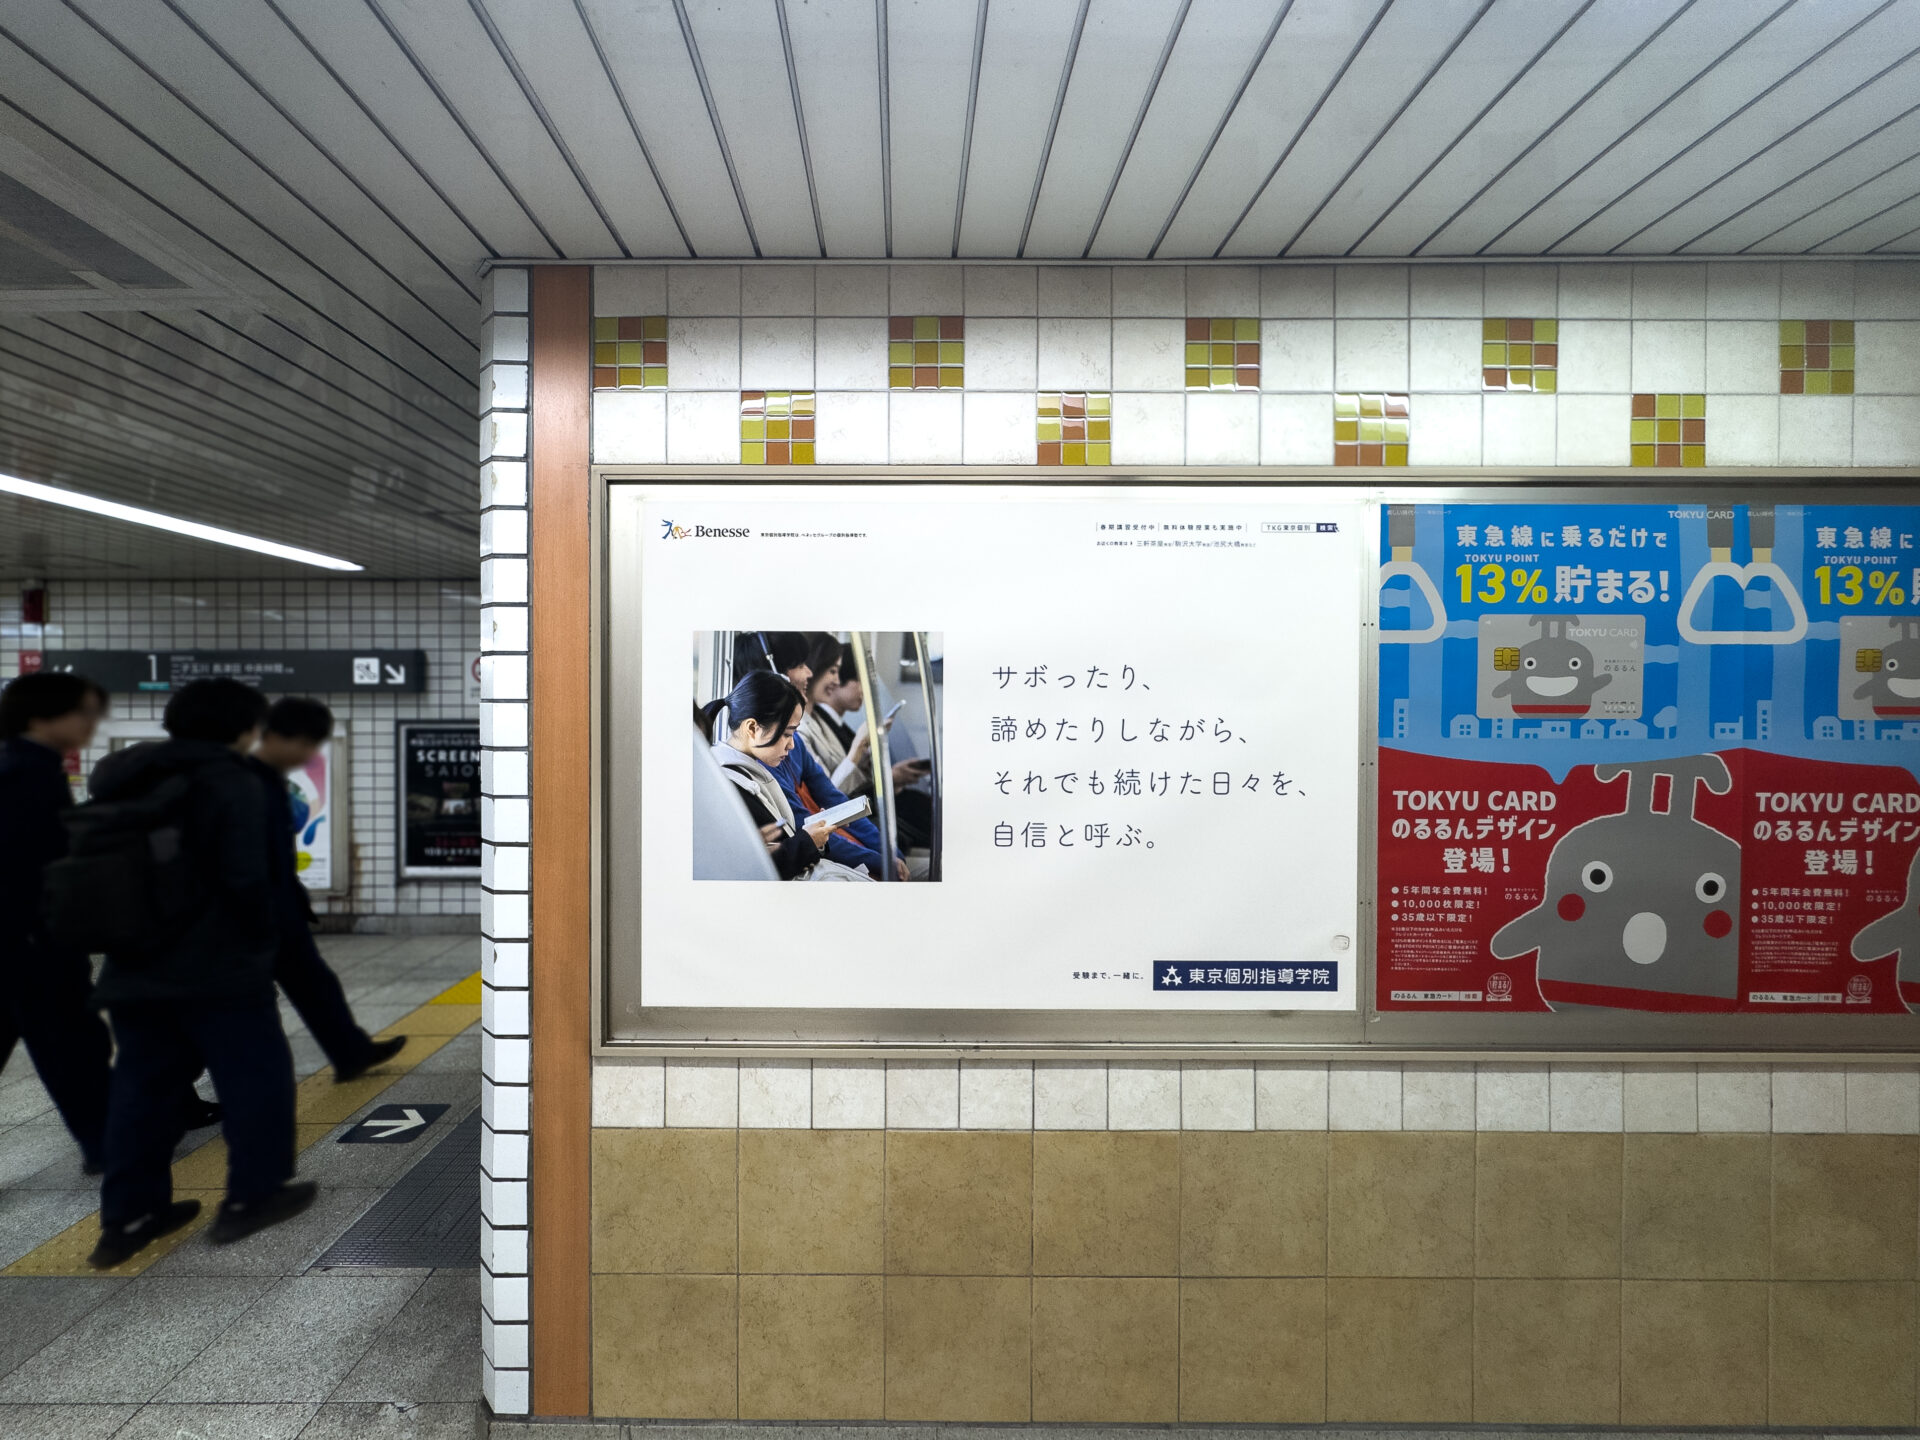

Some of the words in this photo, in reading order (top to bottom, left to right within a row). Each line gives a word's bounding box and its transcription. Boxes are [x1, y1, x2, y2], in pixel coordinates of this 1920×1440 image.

[1667, 509, 1705, 520] TOKYU
[1706, 509, 1736, 520] CARD
[694, 525, 750, 538] Benesse
[1455, 524, 1667, 548] 東急線に乗るだけで
[1464, 552, 1503, 563] TOKYU
[1505, 553, 1540, 564] POINT
[1823, 555, 1861, 565] TOKYU
[1863, 555, 1898, 565] POINT
[1814, 565, 1905, 606] 13%
[1568, 627, 1608, 638] TOKYU
[1608, 627, 1639, 638] CARD
[1603, 664, 1637, 672] のるるん
[991, 664, 1150, 691] サボったり、
[990, 715, 1247, 744] 諦めたりしながら、
[994, 768, 1306, 797] それでも続けた日々を、
[1392, 790, 1480, 812] TOKYU
[1486, 790, 1558, 812] CARD
[1755, 791, 1845, 814] TOKYU
[1851, 792, 1920, 814] CARD
[1391, 814, 1557, 841] のるるんデザイン
[1753, 817, 1920, 843] のるるんデザイン
[994, 820, 1155, 849] 自信と呼ぶ。
[1442, 847, 1511, 874] 登場!
[1803, 849, 1874, 876] 登場!
[1403, 885, 1488, 896] 5年間年会費無料!
[1504, 893, 1538, 901] のるるん
[1761, 886, 1850, 899] 5年間年会費無料!
[1402, 899, 1480, 910] 10,000枚限定!
[1865, 894, 1900, 903] のるるん
[1761, 901, 1842, 913] 10,000枚限定!
[1401, 912, 1472, 923] 35歳以下限定!
[1760, 914, 1834, 926] 35歳以下限定!
[1072, 971, 1144, 980] 受験まで、一緒に。
[1188, 967, 1330, 985] 東京個別指導学院
[1393, 992, 1418, 1000] のるるん
[1751, 993, 1776, 1002] のるるん
